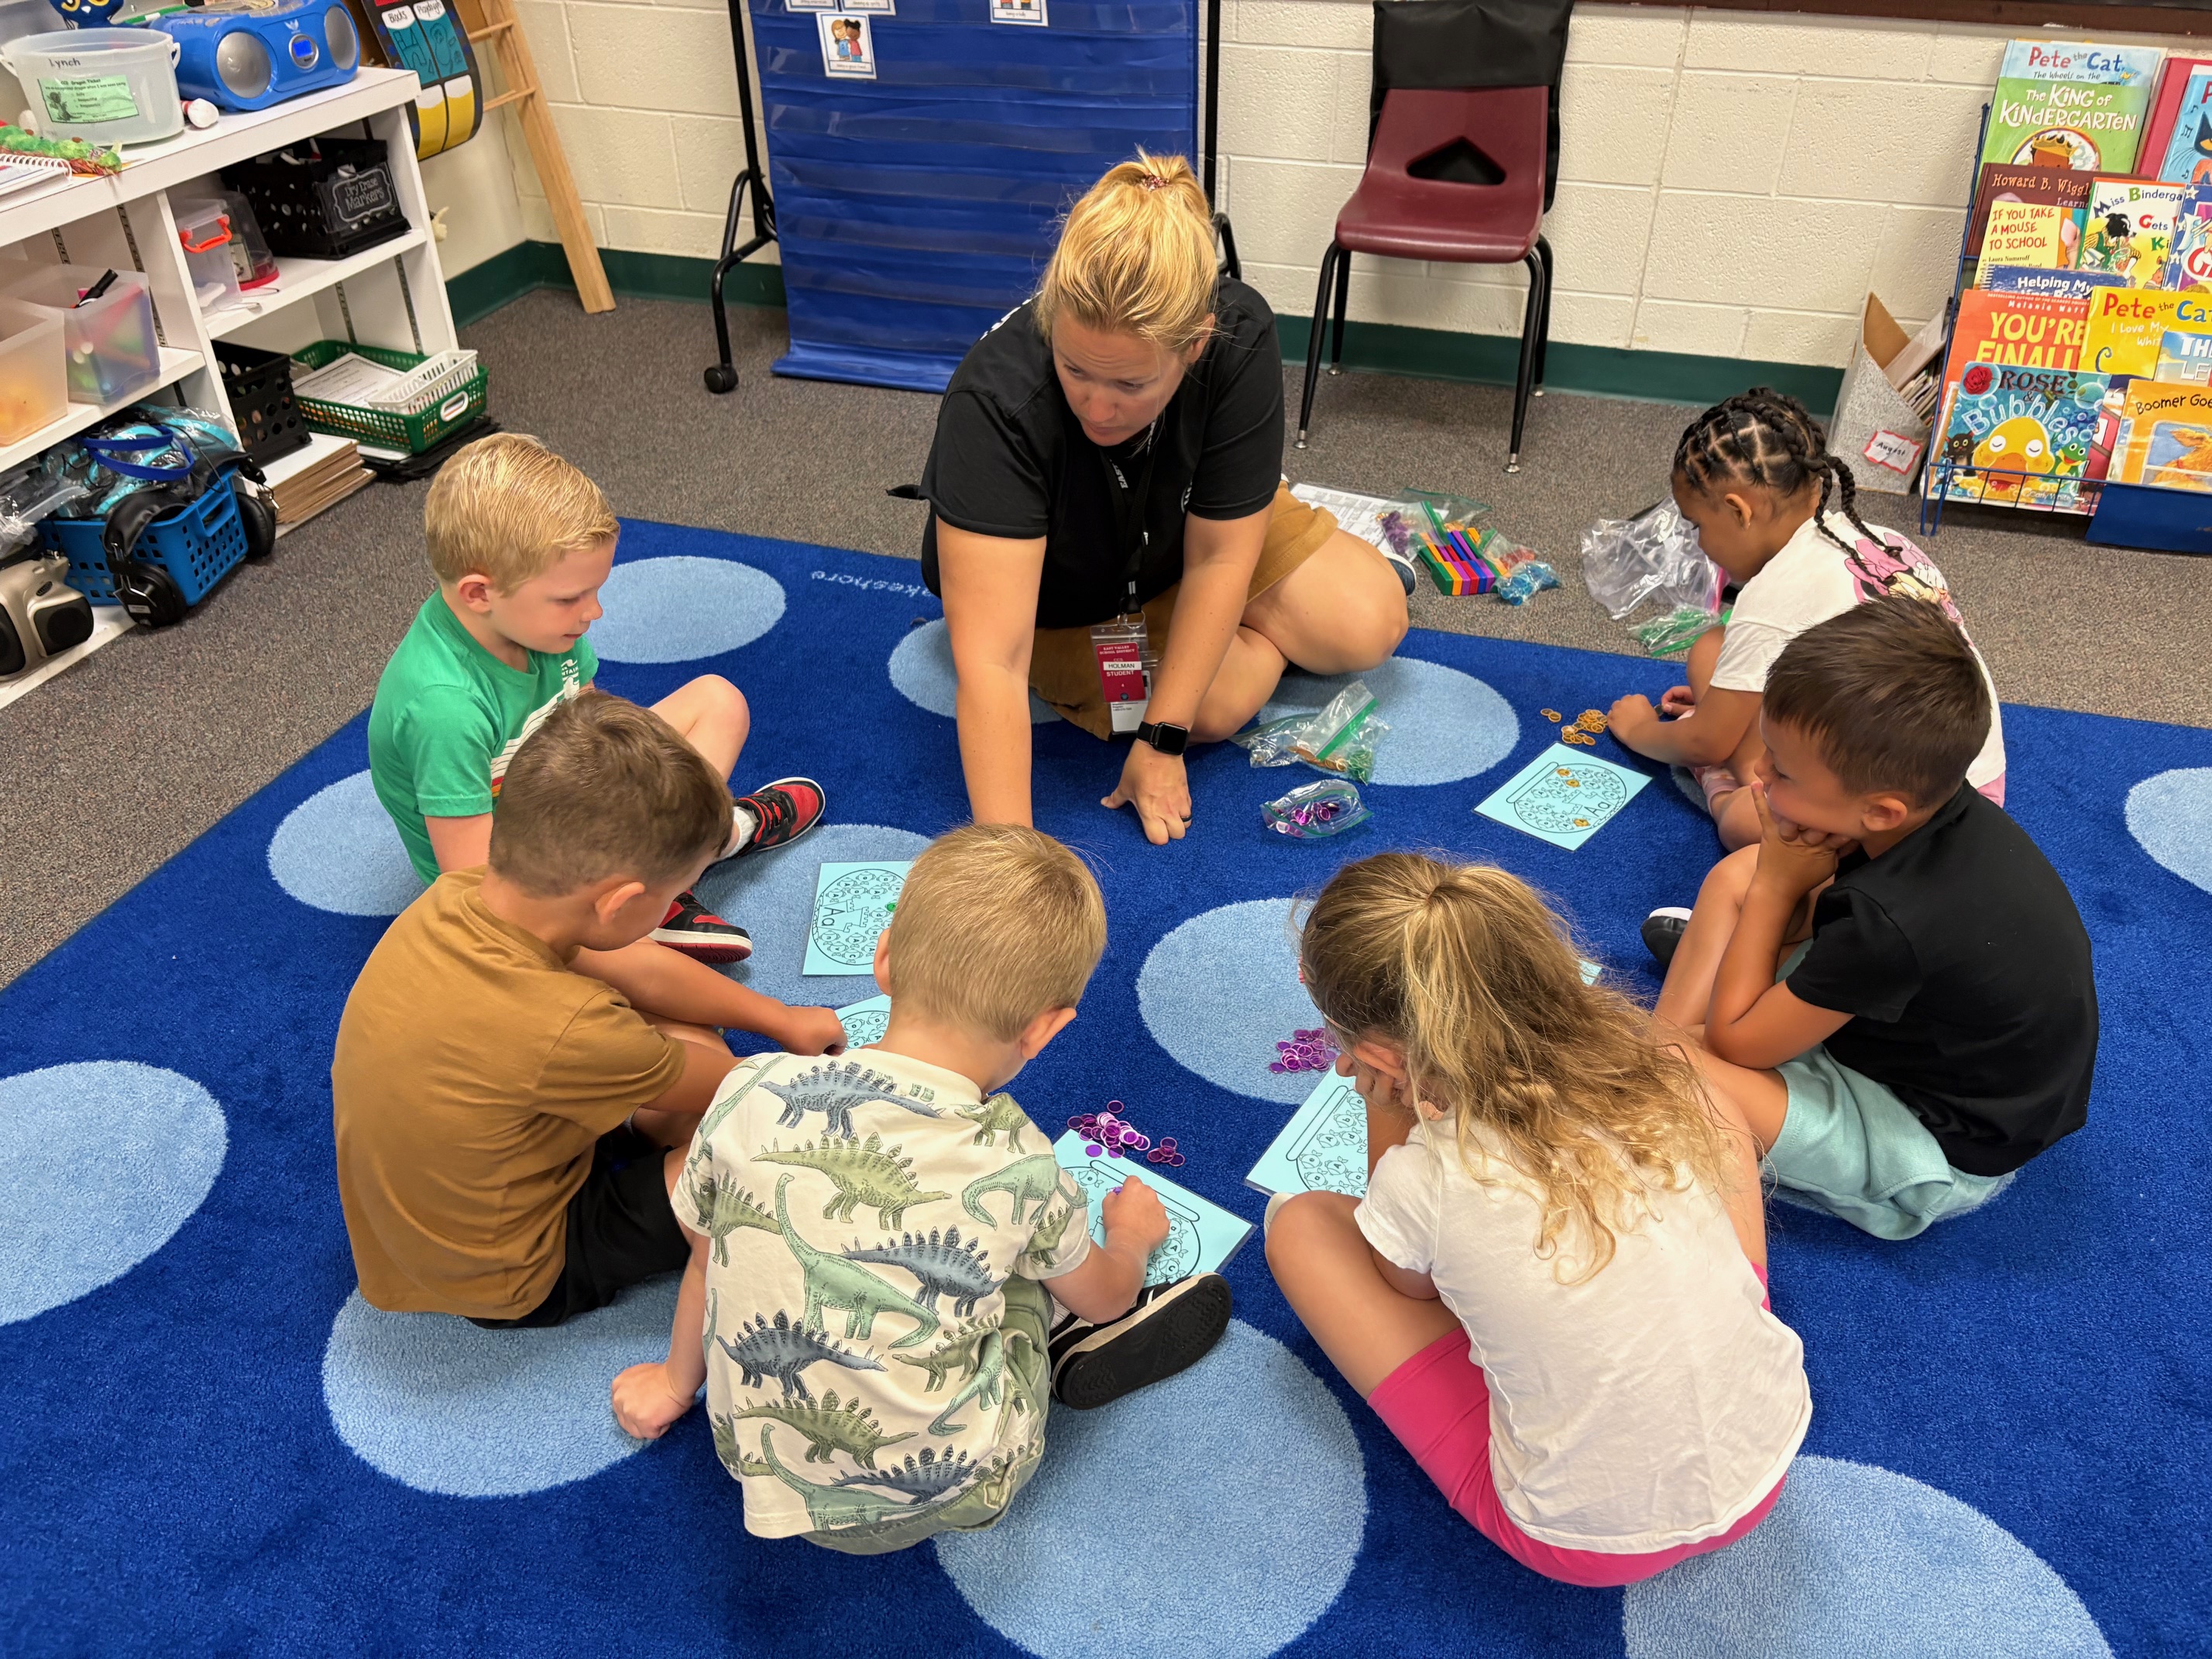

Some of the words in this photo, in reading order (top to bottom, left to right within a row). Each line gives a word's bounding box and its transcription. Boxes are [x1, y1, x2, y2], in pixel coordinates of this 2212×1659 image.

[388, 10, 408, 23] Blocks
[48, 57, 81, 68] Lynch
[2028, 46, 2071, 68] Pete
[2073, 51, 2088, 61] the
[2026, 90, 2046, 101] The
[2097, 94, 2112, 107] of
[345, 184, 359, 197] Dry
[359, 177, 379, 191] Erase
[1992, 174, 2036, 187] Howard
[2040, 177, 2051, 191] B.
[345, 187, 385, 211] Markers
[2094, 196, 2125, 218] Miss
[1992, 208, 2004, 222] IF
[2006, 208, 2026, 220] YOU
[2030, 208, 2055, 219] TAKE
[2138, 214, 2168, 231] Gets
[1990, 224, 1997, 235] A
[2001, 222, 2038, 235] MOUSE
[1989, 239, 2002, 251] TO
[2006, 236, 2047, 249] SCHOOL
[2018, 276, 2070, 291] Helping
[2072, 280, 2094, 296] My
[2008, 301, 2052, 311] Melanie
[2059, 305, 2085, 314] Watt
[2103, 293, 2156, 319] Pete
[2159, 302, 2175, 311] the
[1990, 311, 2087, 347] YOU'RE
[2111, 322, 2115, 334] I
[2120, 323, 2145, 334] Love
[2149, 321, 2170, 332] My
[1999, 369, 2069, 395] ROSE
[2135, 395, 2186, 415] Boomer
[1961, 393, 2079, 445] Bubbles
[1876, 441, 1906, 455] August
[821, 907, 845, 926] Aa
